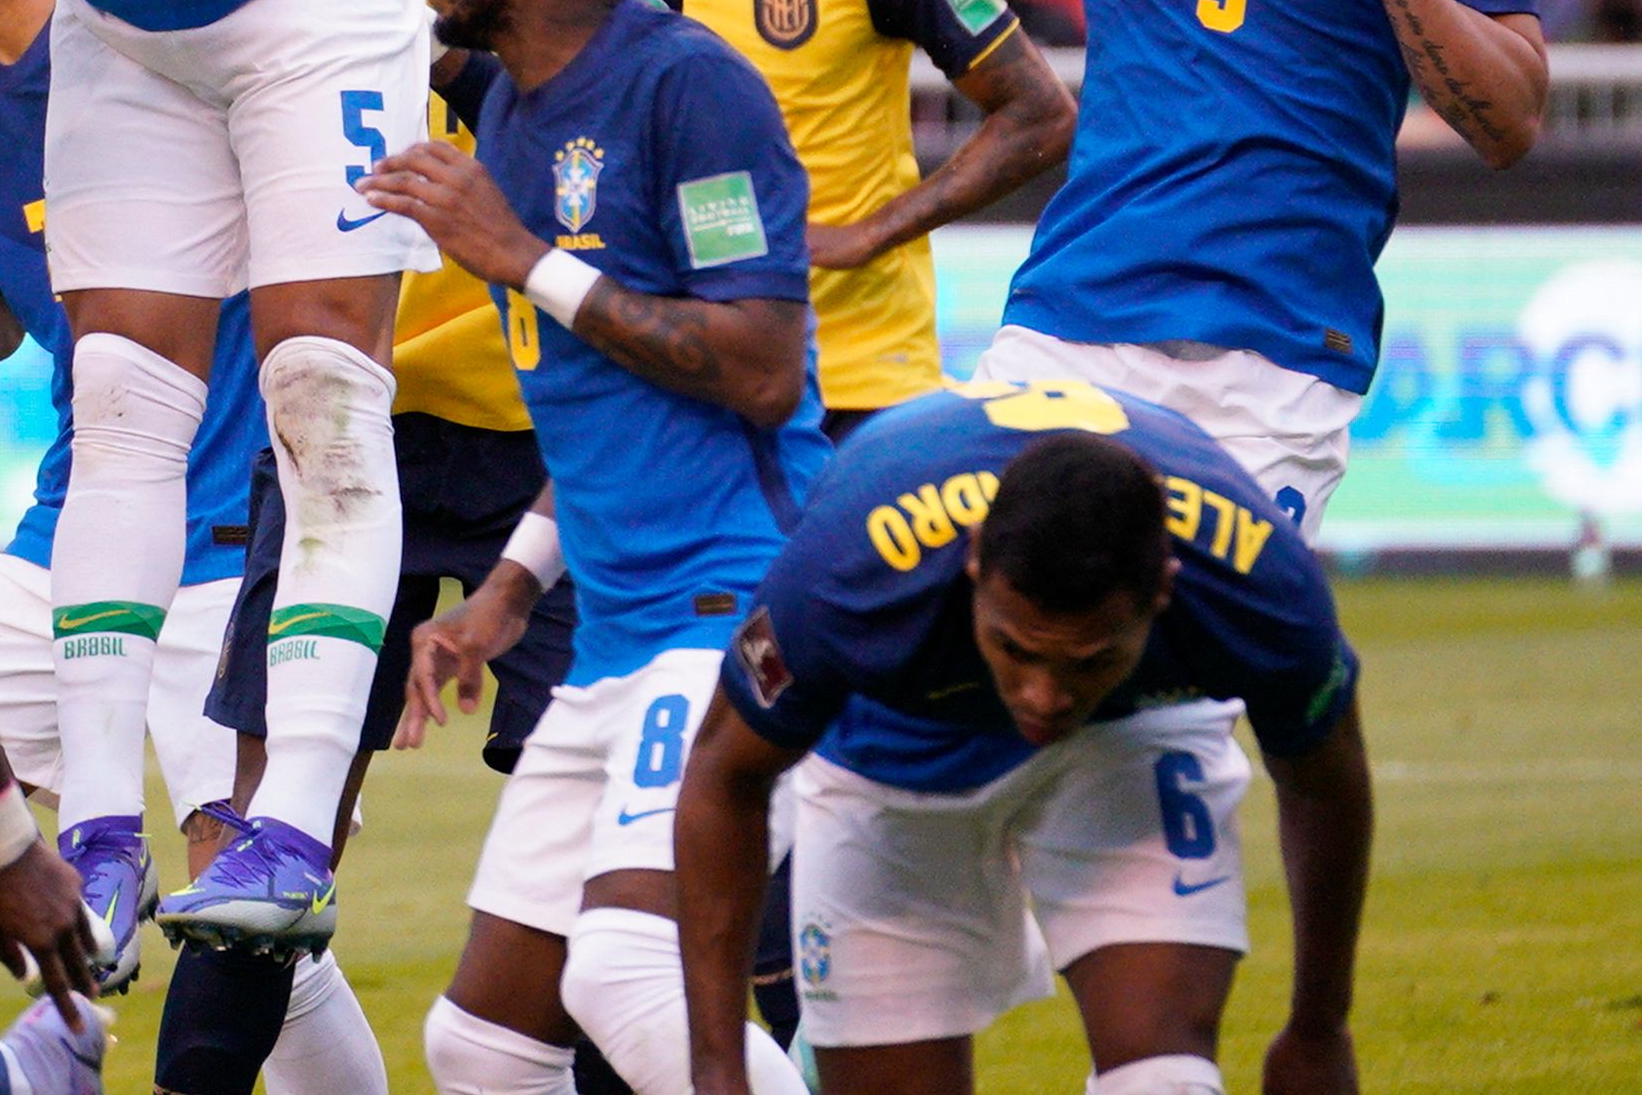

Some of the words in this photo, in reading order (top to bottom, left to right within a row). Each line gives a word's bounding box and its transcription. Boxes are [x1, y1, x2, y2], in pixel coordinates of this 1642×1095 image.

[340, 90, 387, 194] 5
[63, 636, 127, 660] BRASIL
[269, 640, 321, 667] BRASIL
[633, 694, 690, 789] 8
[1154, 751, 1216, 859] 6
